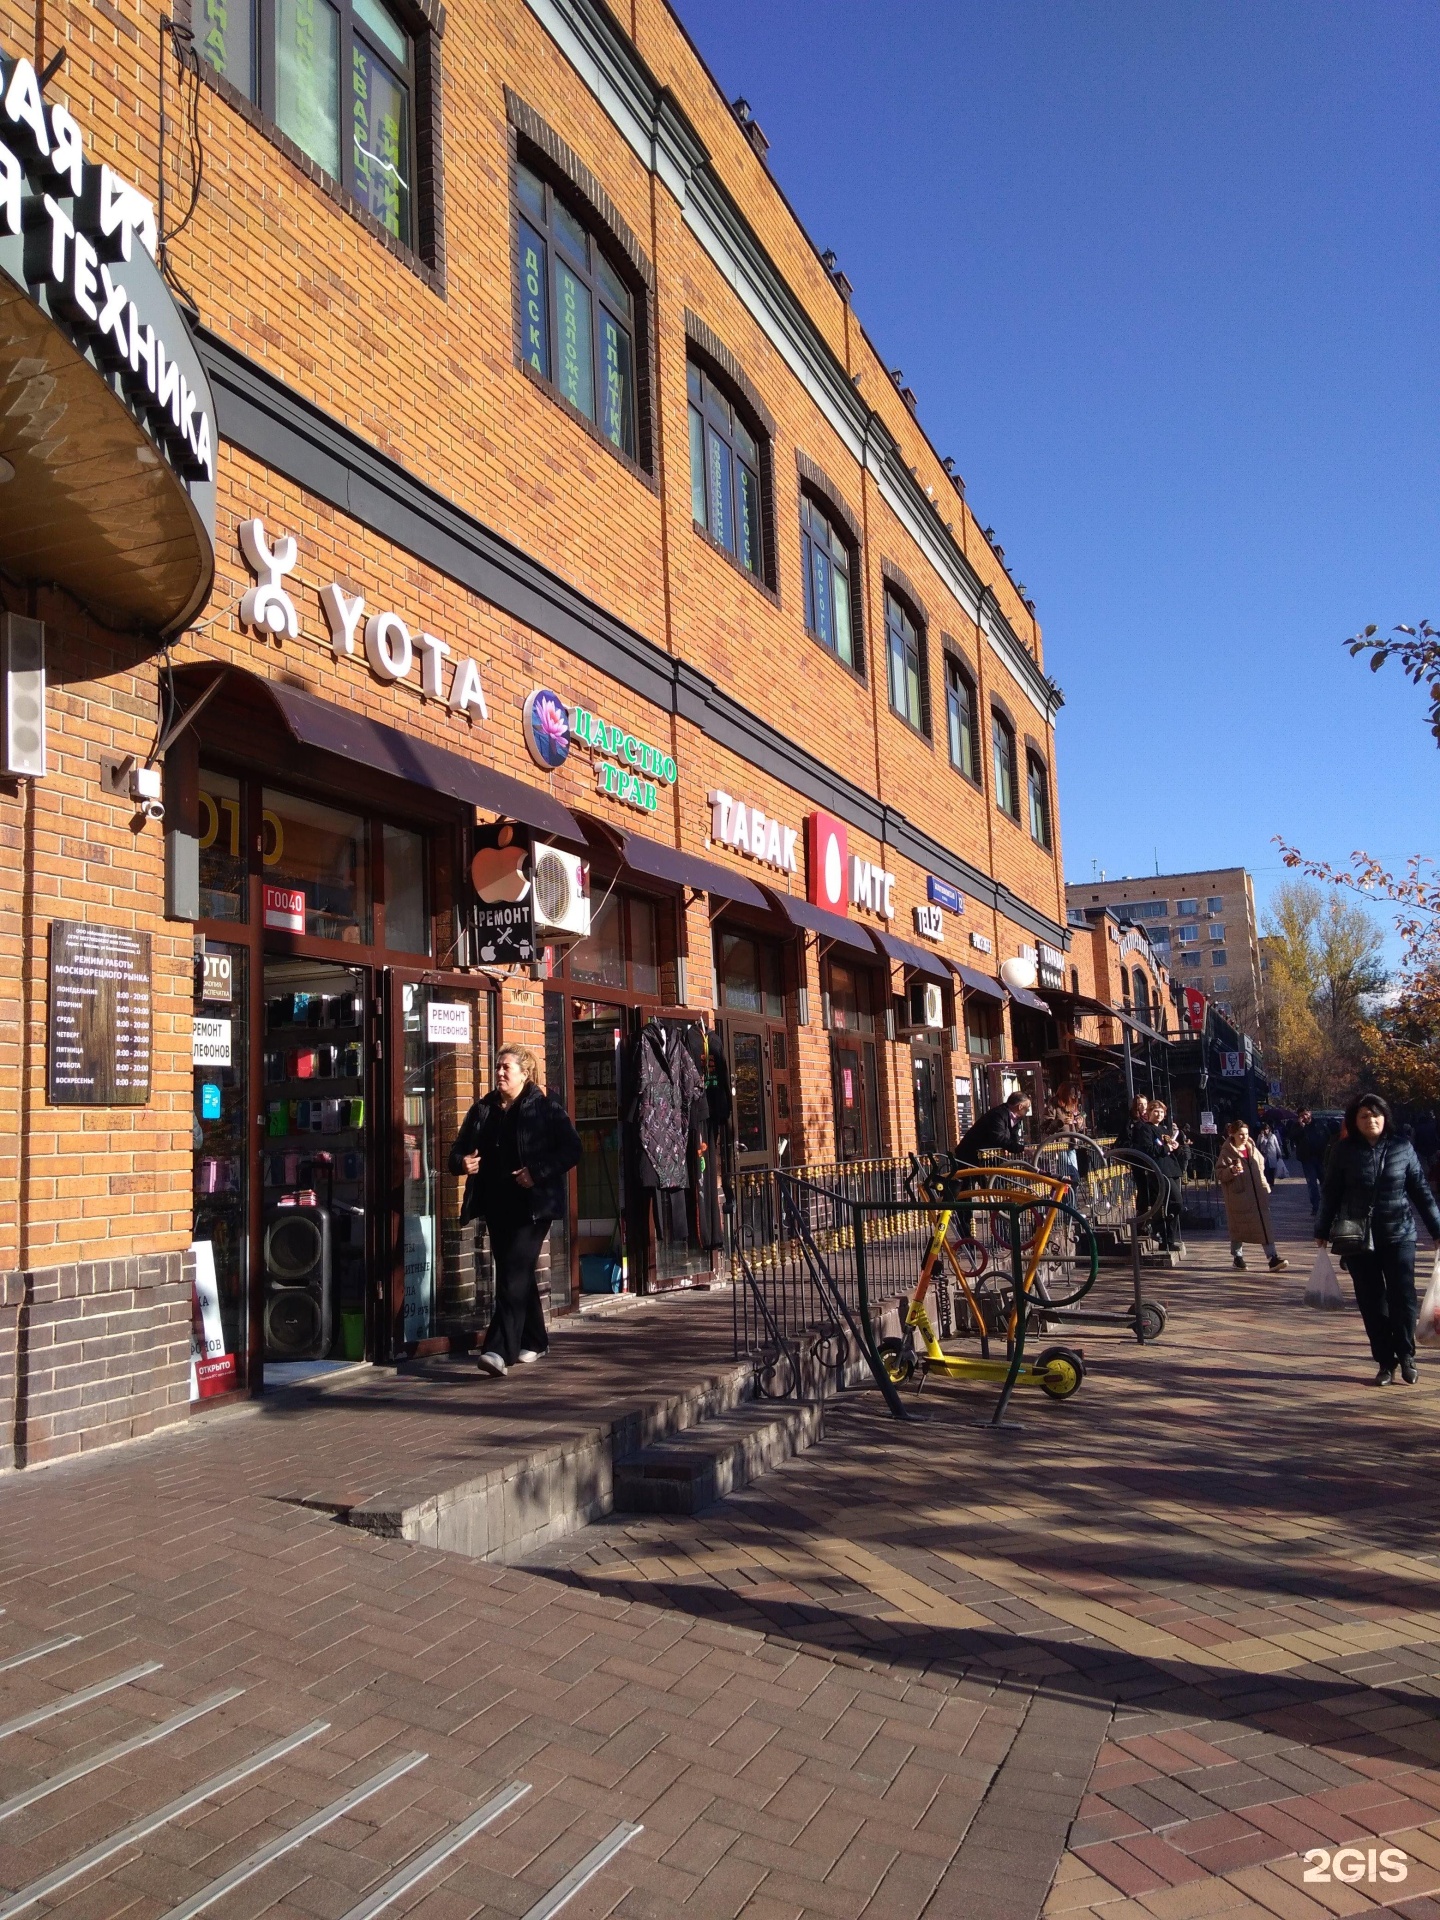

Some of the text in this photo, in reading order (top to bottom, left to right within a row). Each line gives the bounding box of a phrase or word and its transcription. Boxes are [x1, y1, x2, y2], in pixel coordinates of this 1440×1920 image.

[0, 57, 82, 197] АЯ
[525, 247, 542, 374] ДОСКА
[44, 195, 213, 482] ТЕХНИКА
[564, 274, 579, 408] ПОДЛОЖКА
[606, 322, 621, 448] ПЛИТКА
[741, 471, 753, 572] ОТКОСЫ
[816, 553, 827, 642] ПОРОГИ
[320, 582, 489, 720] YOTA
[574, 706, 677, 784] ЦАРСТВО
[600, 763, 658, 812] ТРАВ
[710, 790, 798, 873] ТАБАК
[850, 856, 895, 919] МТС
[478, 906, 530, 927] РЕМОНТ
[917, 905, 944, 942] TELE2
[75, 955, 134, 969] РЕЖИМ РАБОТЫ
[55, 966, 150, 983] МОСКВОРЕЦКОГО РЫНКА:
[56, 986, 98, 996] ПОНЕДЕЛЬНИК
[116, 992, 129, 1000] 8:00
[133, 992, 149, 1001] 20:00
[56, 1001, 83, 1009] ВТОРНИК
[116, 1006, 129, 1014] 8:00
[133, 1006, 149, 1015] 20:00
[432, 1008, 466, 1023] РЕМОНТ
[56, 1016, 75, 1024] СРЕДА
[116, 1020, 129, 1028] 8:00
[133, 1021, 149, 1029] 20:00
[429, 1024, 468, 1037] ТЕЛЕФОНОВ
[56, 1031, 80, 1039] ЧЕТВЕРГ
[116, 1034, 129, 1043] 8:00
[133, 1035, 149, 1044] 20:00
[56, 1046, 84, 1055] ПЯТНИЦА
[116, 1049, 129, 1057] 8:00
[133, 1050, 149, 1058] 20:00
[116, 1064, 129, 1072] 8:00
[56, 1077, 95, 1085] ВОСКРЕСЕНЬЕ
[116, 1078, 129, 1086] 8:00
[133, 1079, 149, 1087] 20:00
[405, 1261, 430, 1275] ИТНЫЕ
[199, 1360, 231, 1375] ОТКРЫТО
